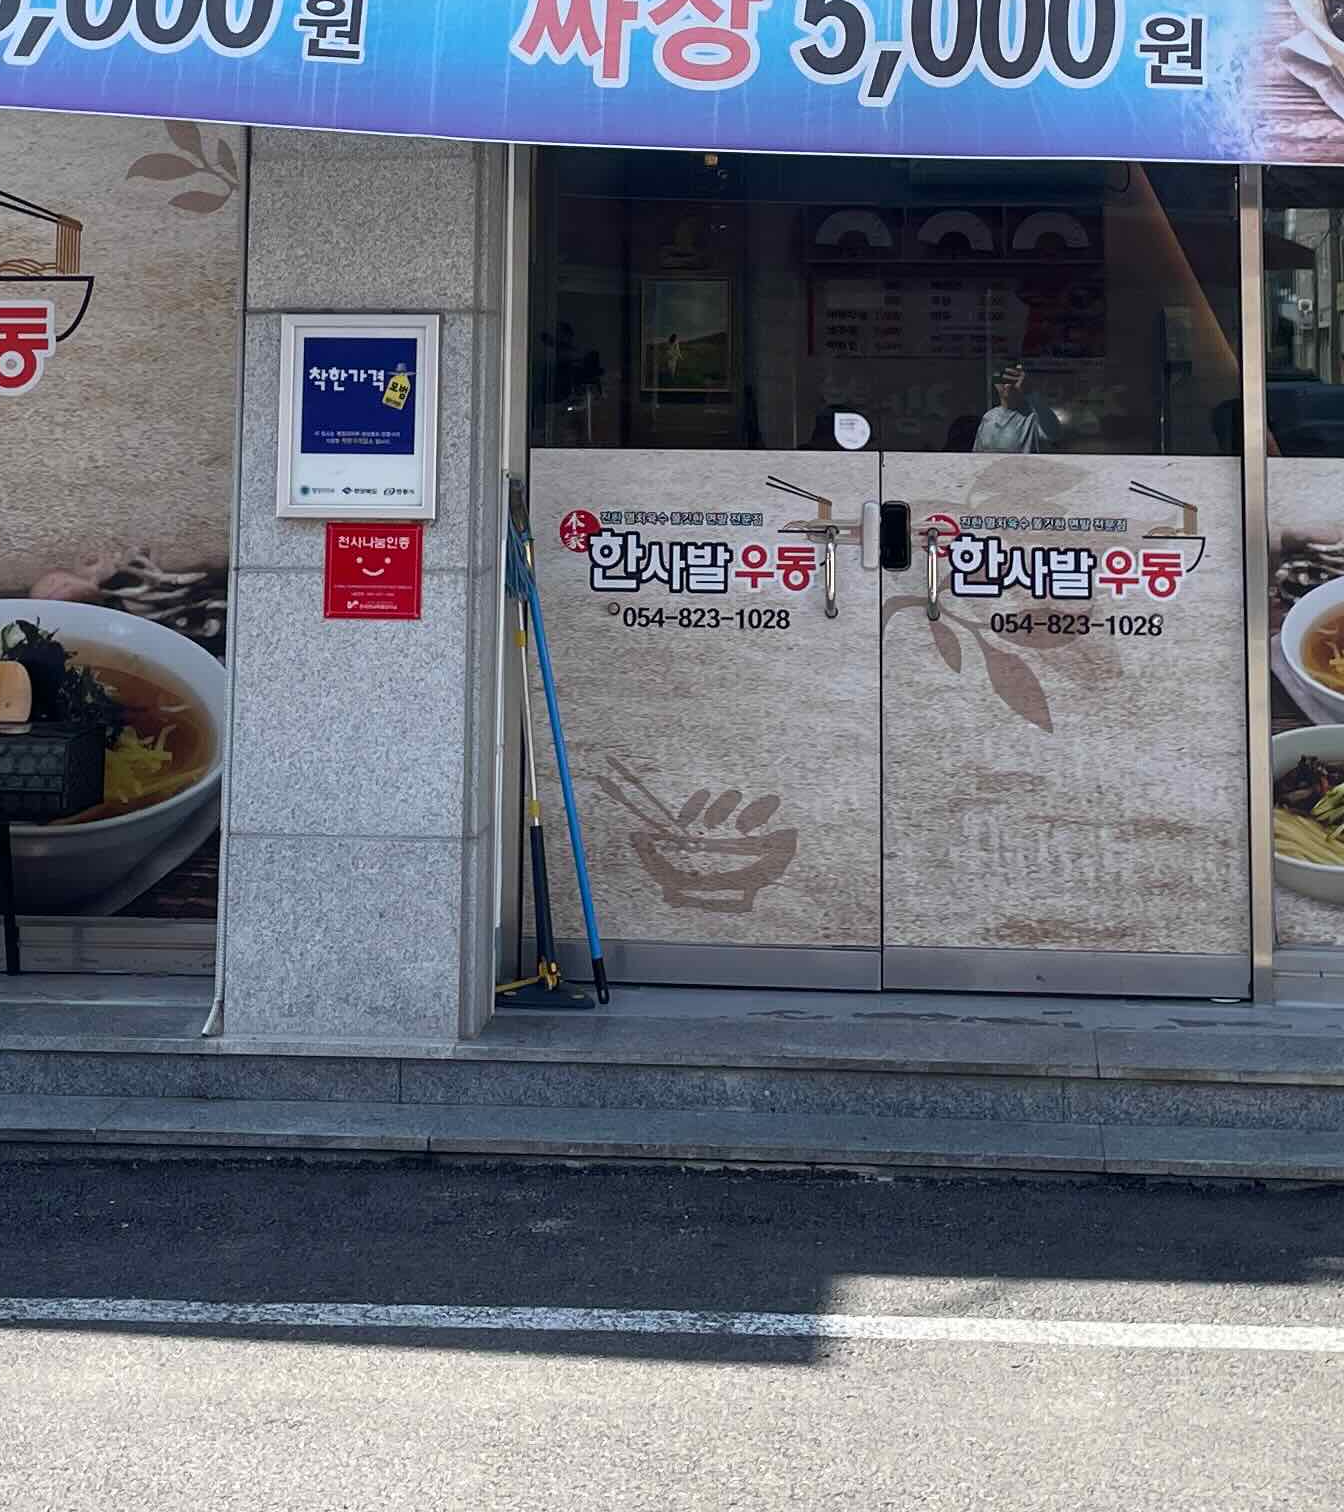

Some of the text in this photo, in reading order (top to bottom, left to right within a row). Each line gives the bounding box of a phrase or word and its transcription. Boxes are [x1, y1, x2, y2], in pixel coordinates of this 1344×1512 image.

[1138, 17, 1207, 86] 원
[309, 366, 386, 392] 착한가격
[337, 535, 411, 550] 천사나눔인증
[589, 528, 818, 594] 한사발우동
[949, 533, 1185, 600] 한사발우동
[623, 607, 791, 630] 054-823-1028
[990, 612, 1164, 637] 054-823-1028
